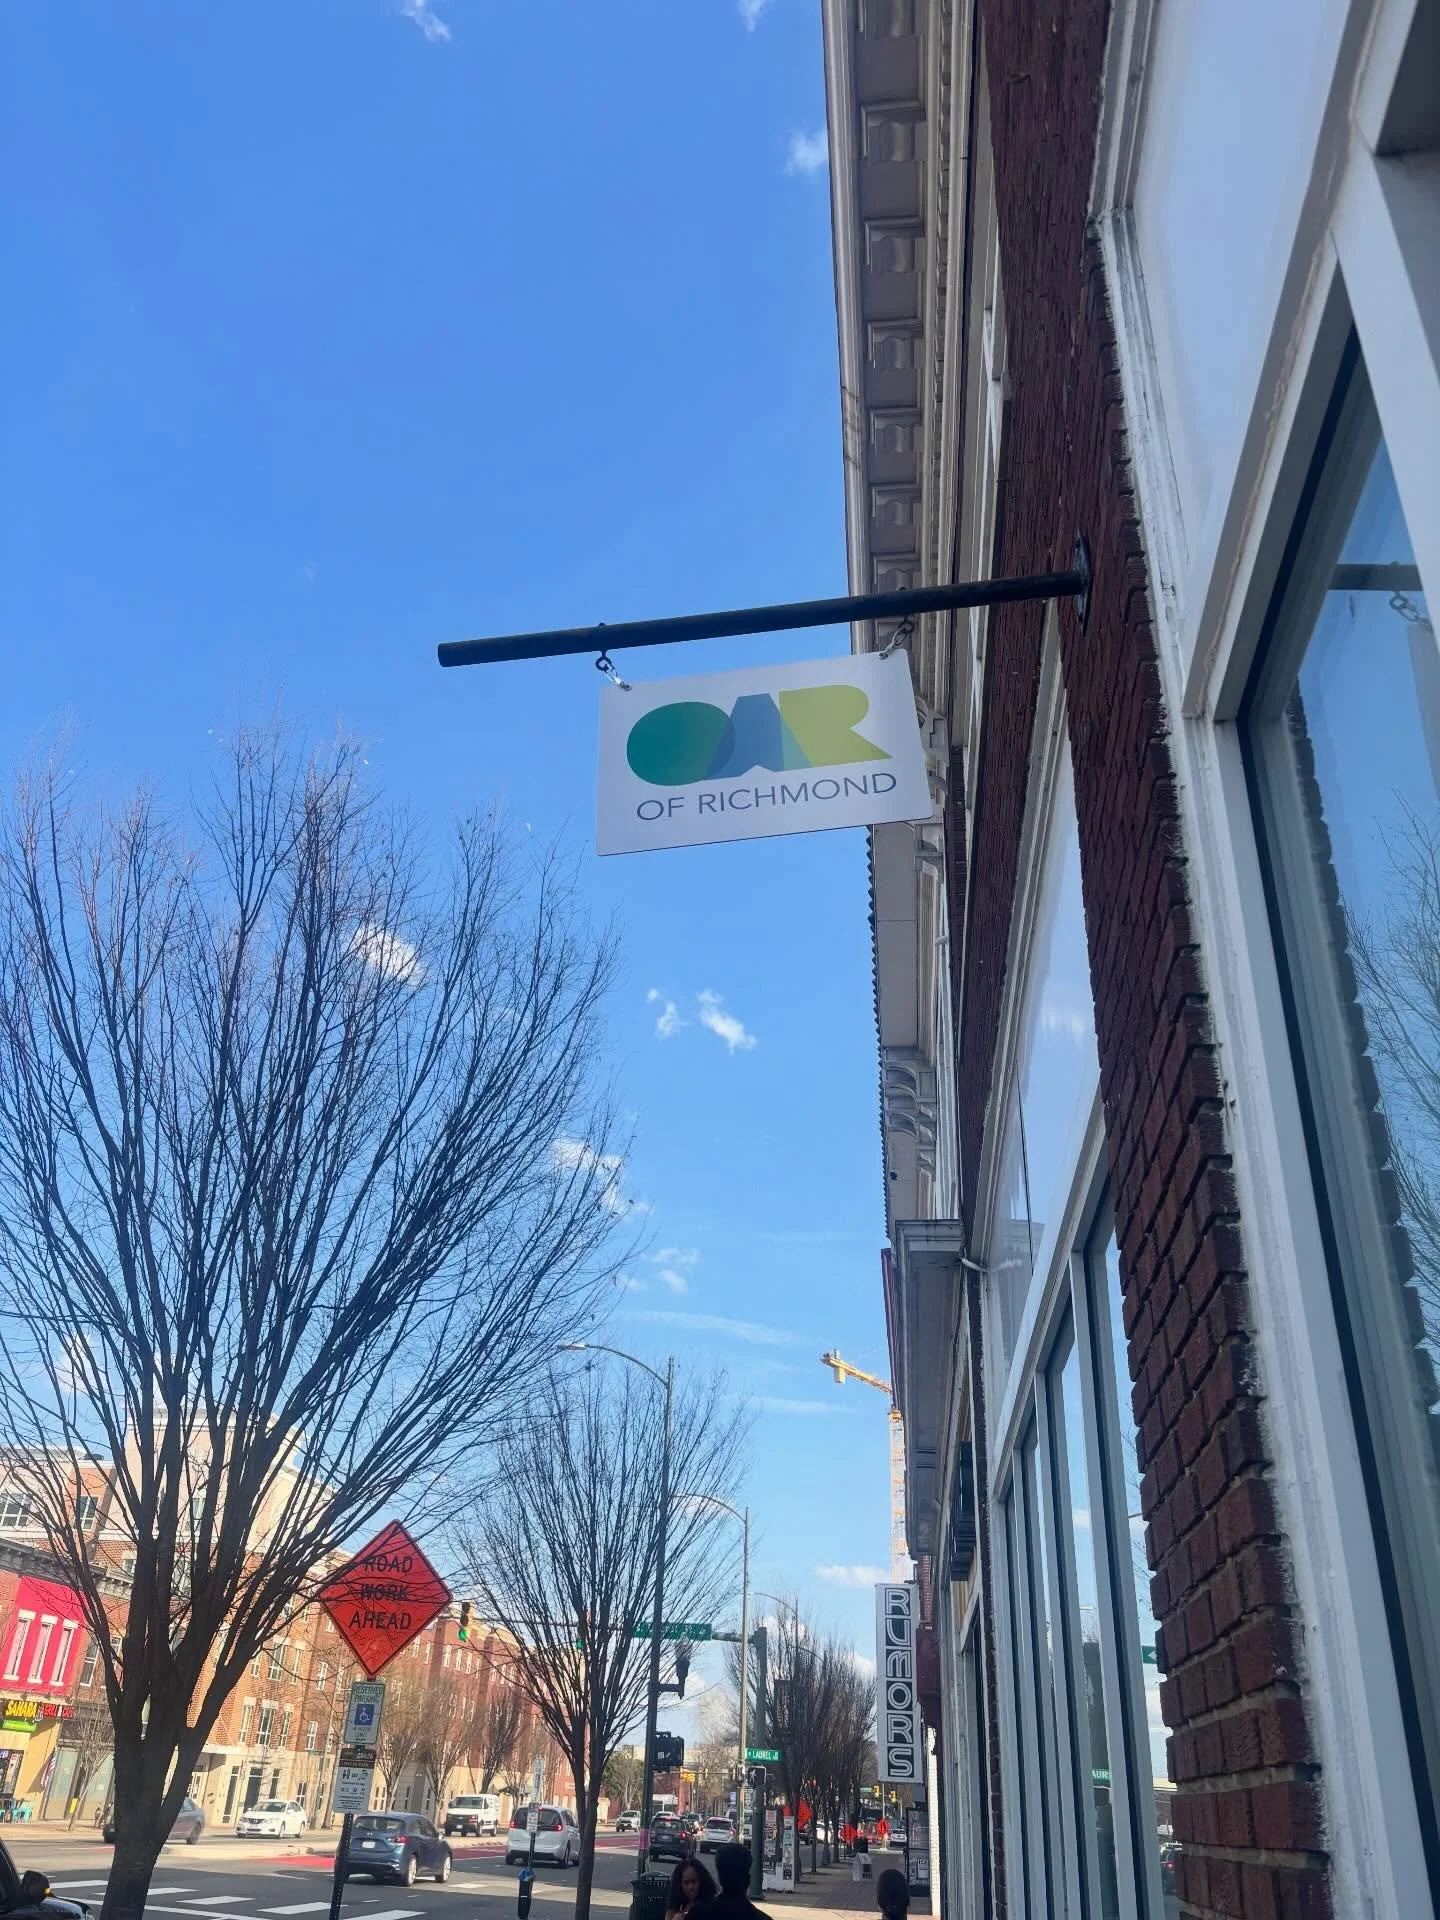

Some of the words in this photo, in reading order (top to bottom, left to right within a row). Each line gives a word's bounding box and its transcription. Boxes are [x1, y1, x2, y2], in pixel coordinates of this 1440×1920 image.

[626, 684, 893, 786] OAR
[636, 796, 686, 821] OF
[698, 772, 897, 815] RICHMOND
[363, 1556, 413, 1573] ROAD
[359, 1584, 410, 1601] WORK
[348, 1610, 412, 1630] AHEAD
[353, 1685, 383, 1694] RESERVED
[885, 1588, 913, 1777] RUMORS
[354, 1694, 380, 1703] PARKING
[5, 1700, 38, 1717] SAHARA
[752, 1749, 771, 1760] LAUREL
